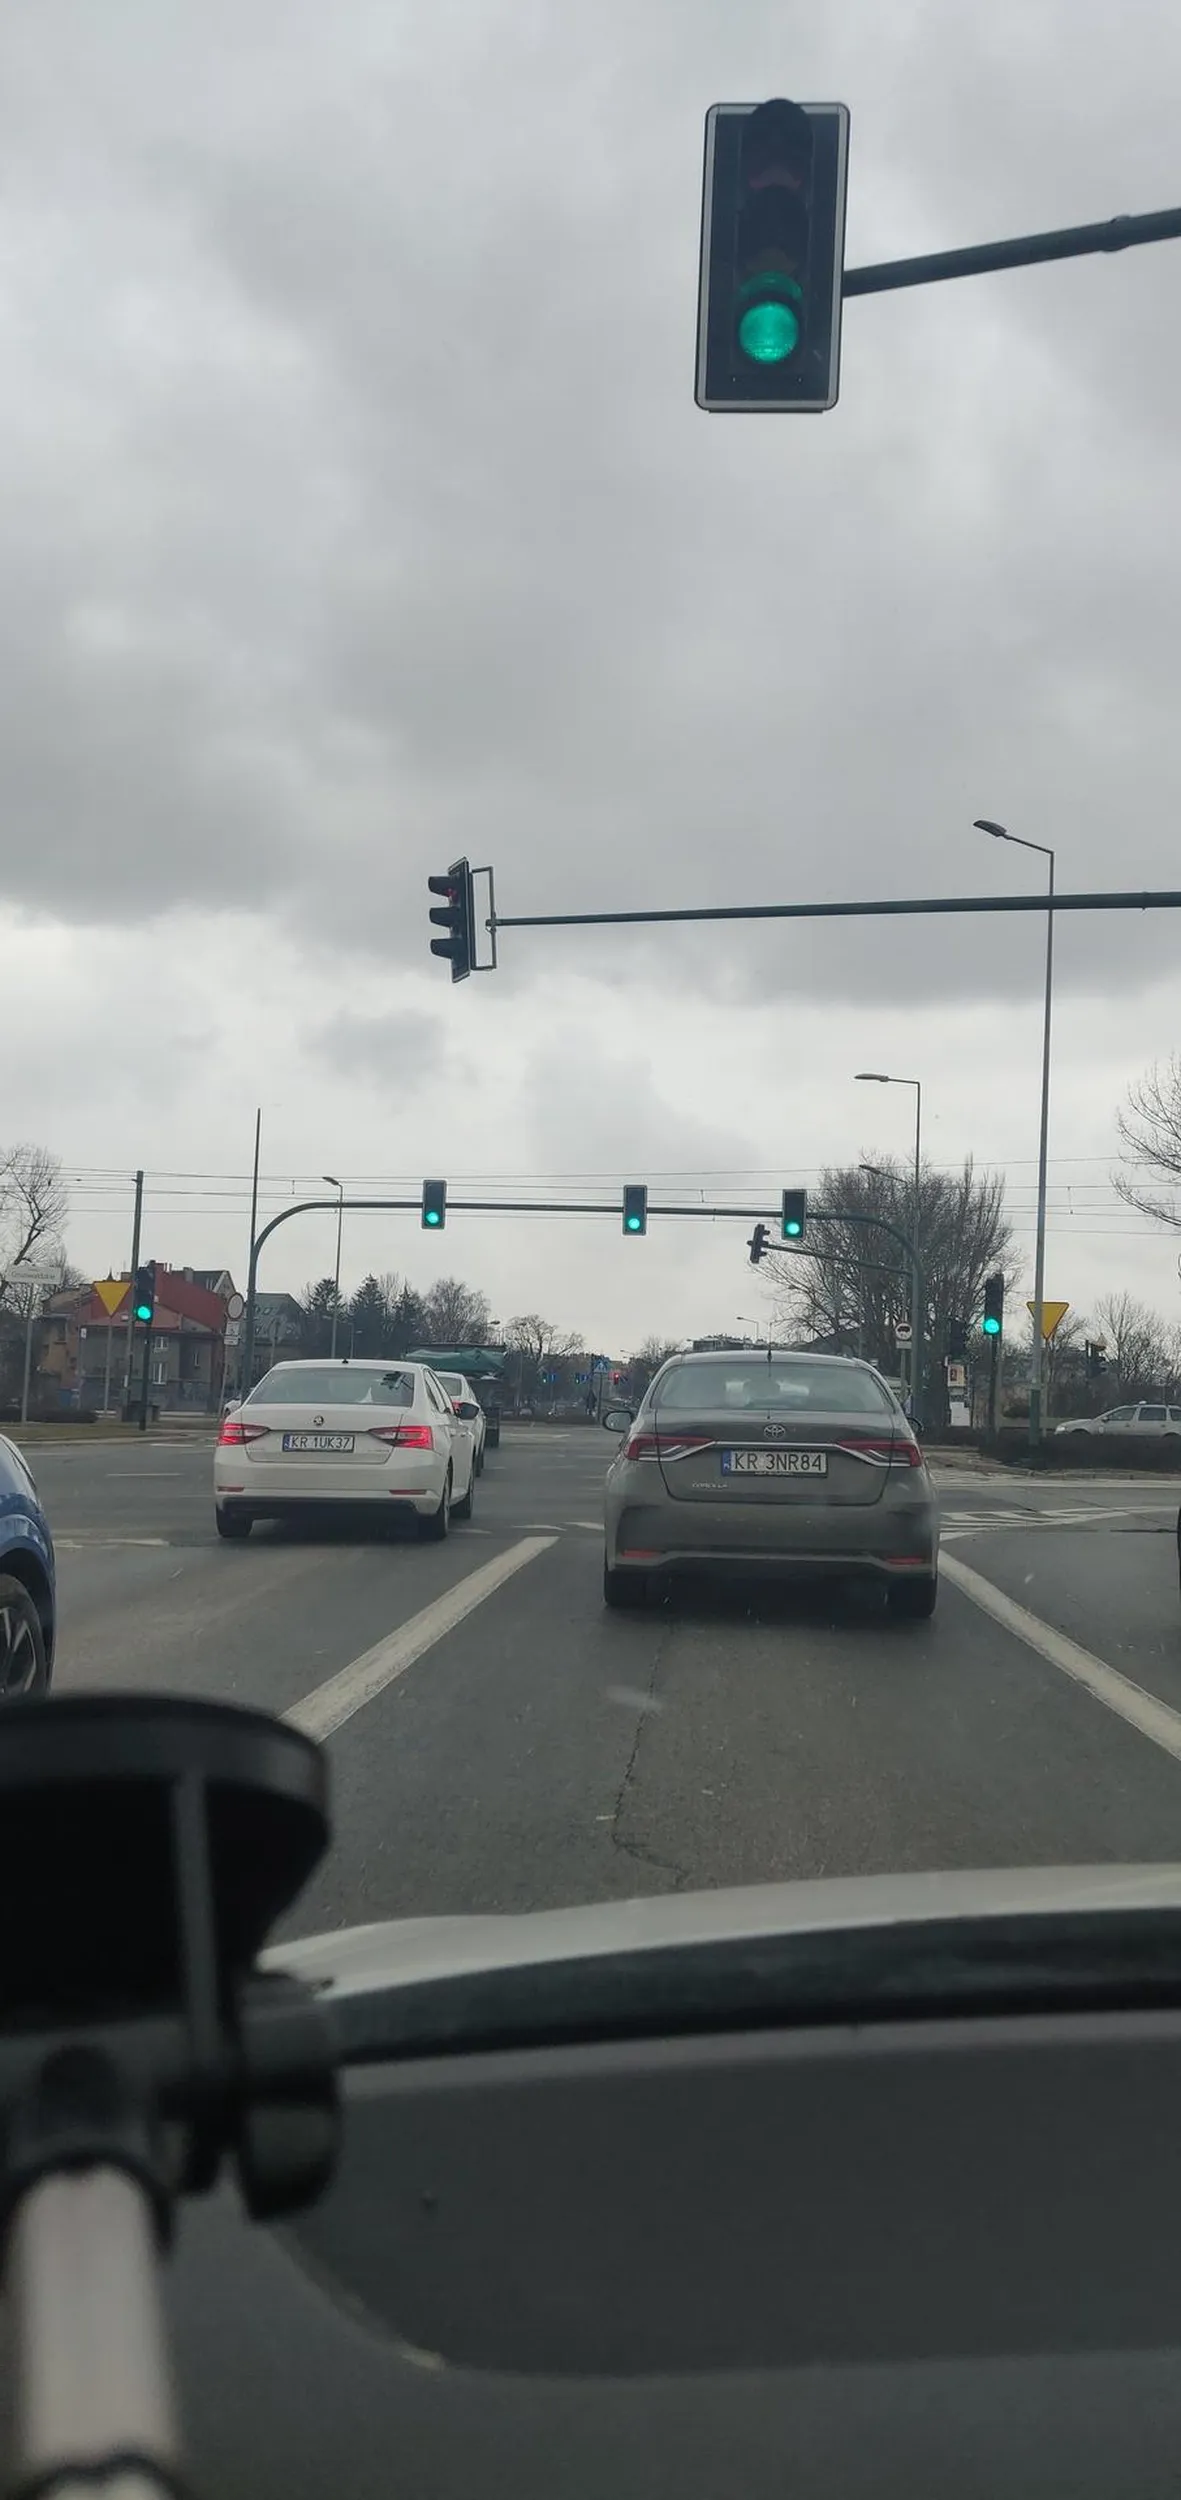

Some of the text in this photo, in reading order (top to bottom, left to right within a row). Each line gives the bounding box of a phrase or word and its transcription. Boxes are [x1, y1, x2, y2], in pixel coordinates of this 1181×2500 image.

[291, 1436, 307, 1448] KR
[314, 1437, 350, 1449] 1UK37
[734, 1453, 822, 1471] KR 3NR84
